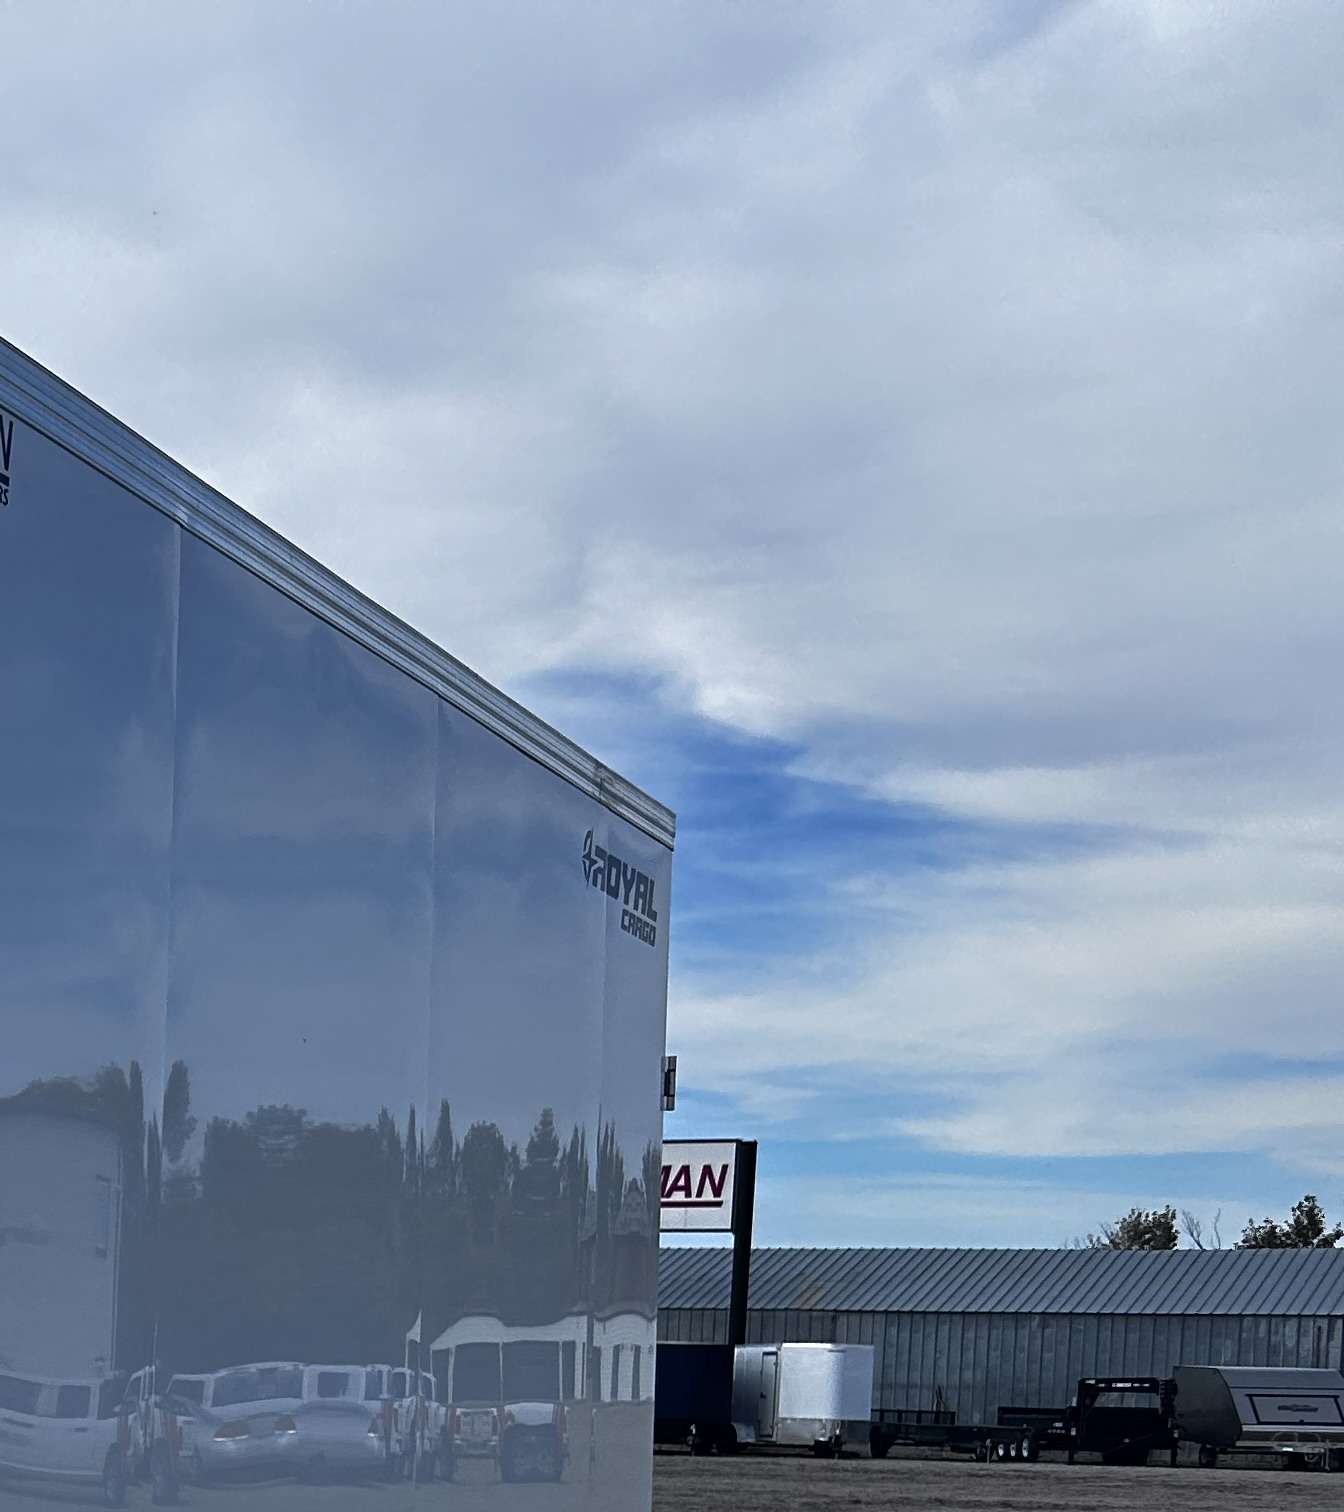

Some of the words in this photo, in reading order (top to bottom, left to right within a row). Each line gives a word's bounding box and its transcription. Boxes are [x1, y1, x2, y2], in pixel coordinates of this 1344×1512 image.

[592, 845, 658, 922] ROYAL
[620, 908, 657, 947] CARGO
[662, 1164, 729, 1198] AN
